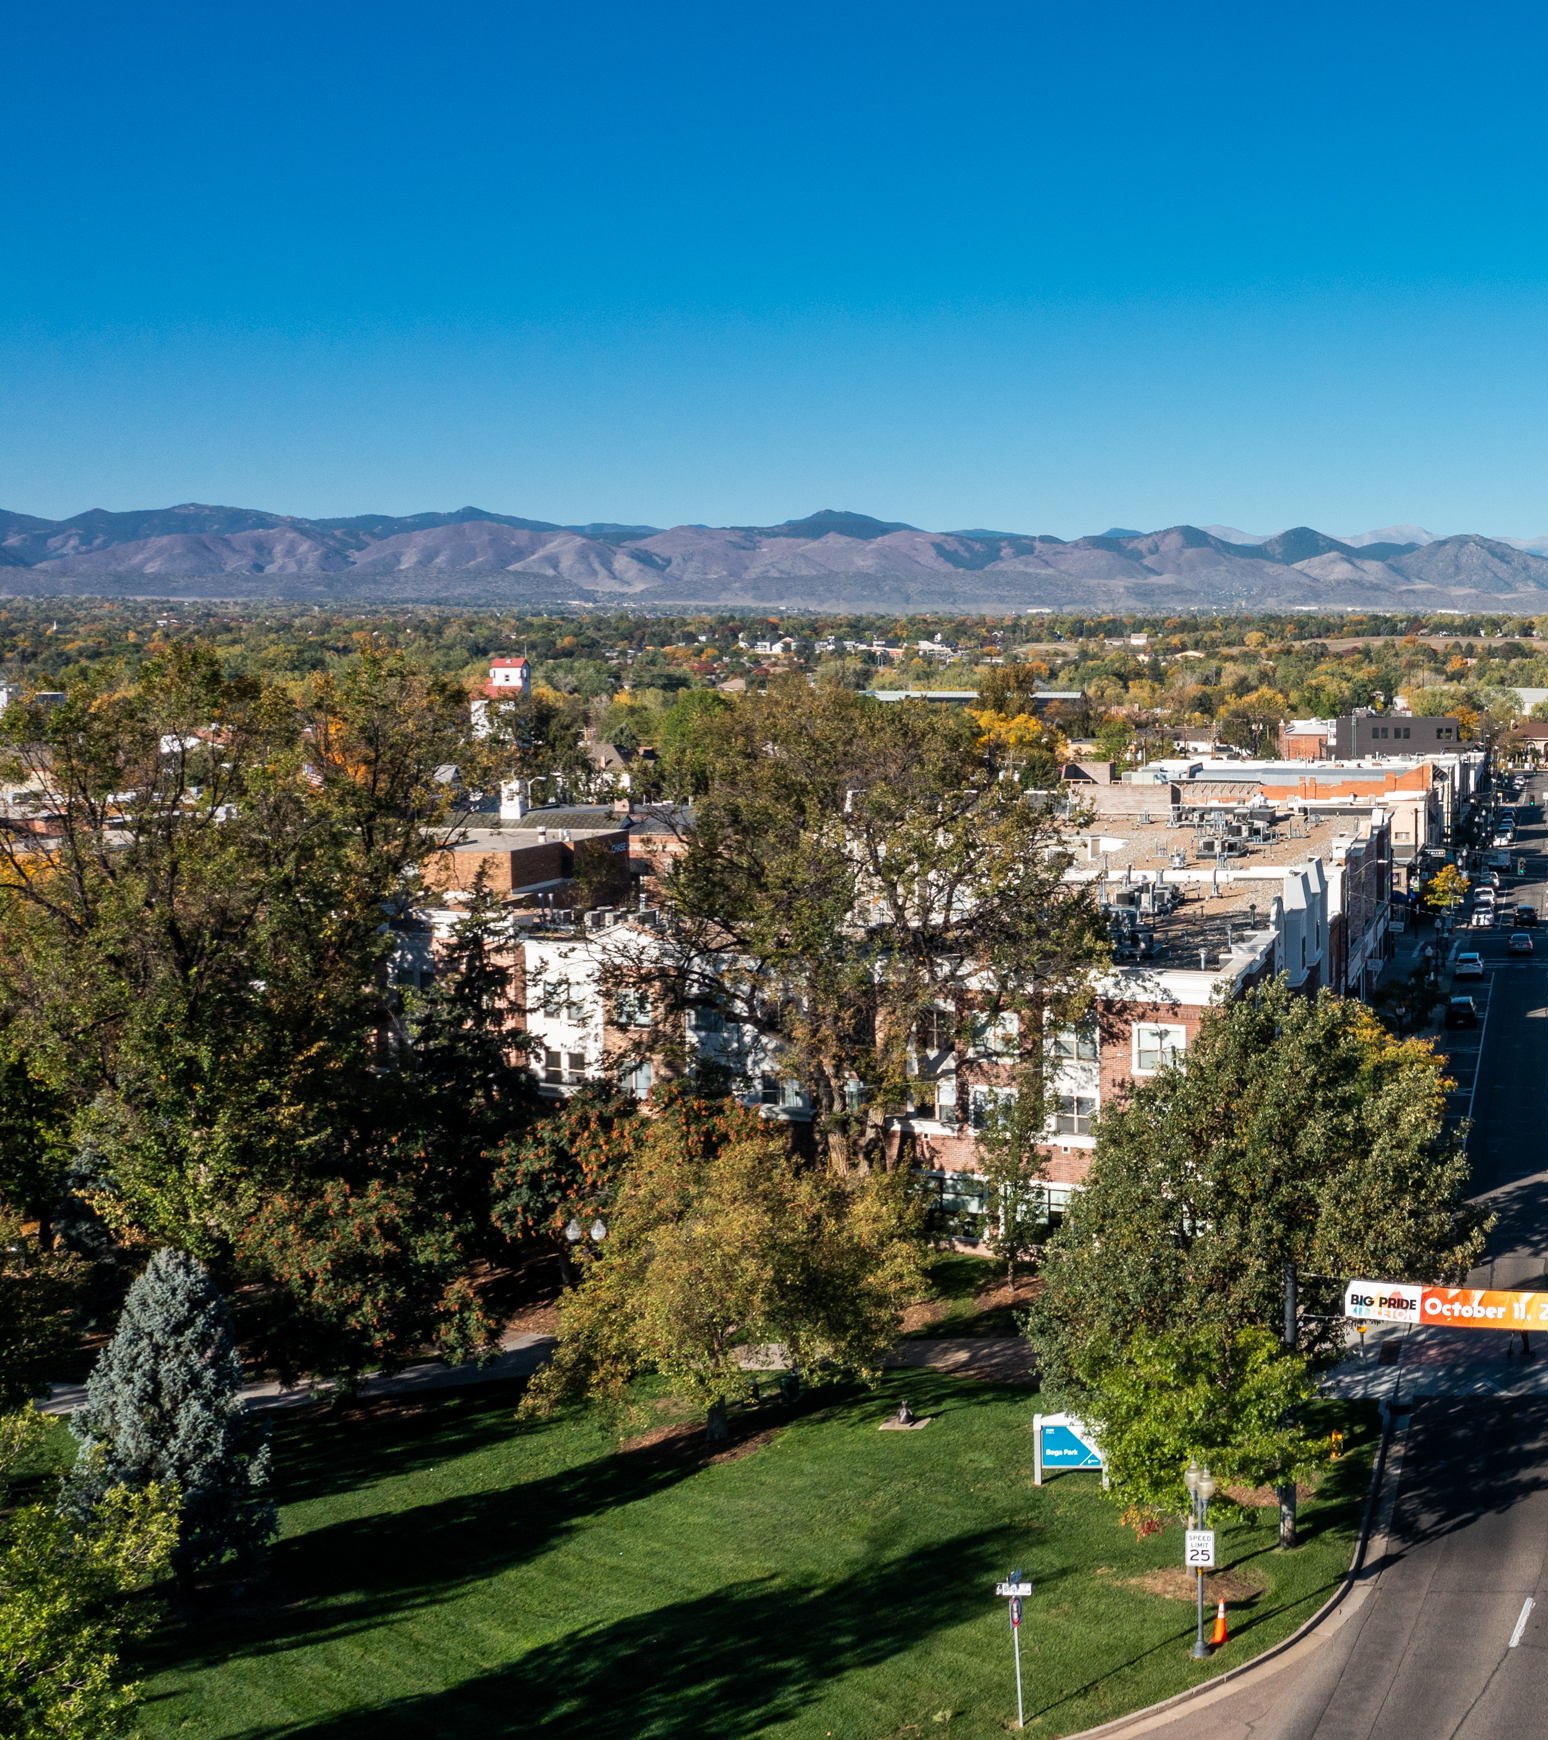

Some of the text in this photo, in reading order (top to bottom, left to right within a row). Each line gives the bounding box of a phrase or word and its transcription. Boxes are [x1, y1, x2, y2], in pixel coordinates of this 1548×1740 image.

[1350, 1293, 1417, 1311] BIG PRIDE
[1424, 1297, 1507, 1319] October
[1513, 1302, 1533, 1322] 11,
[1045, 1448, 1079, 1457] Bega Park
[1190, 1549, 1210, 1562] 25
